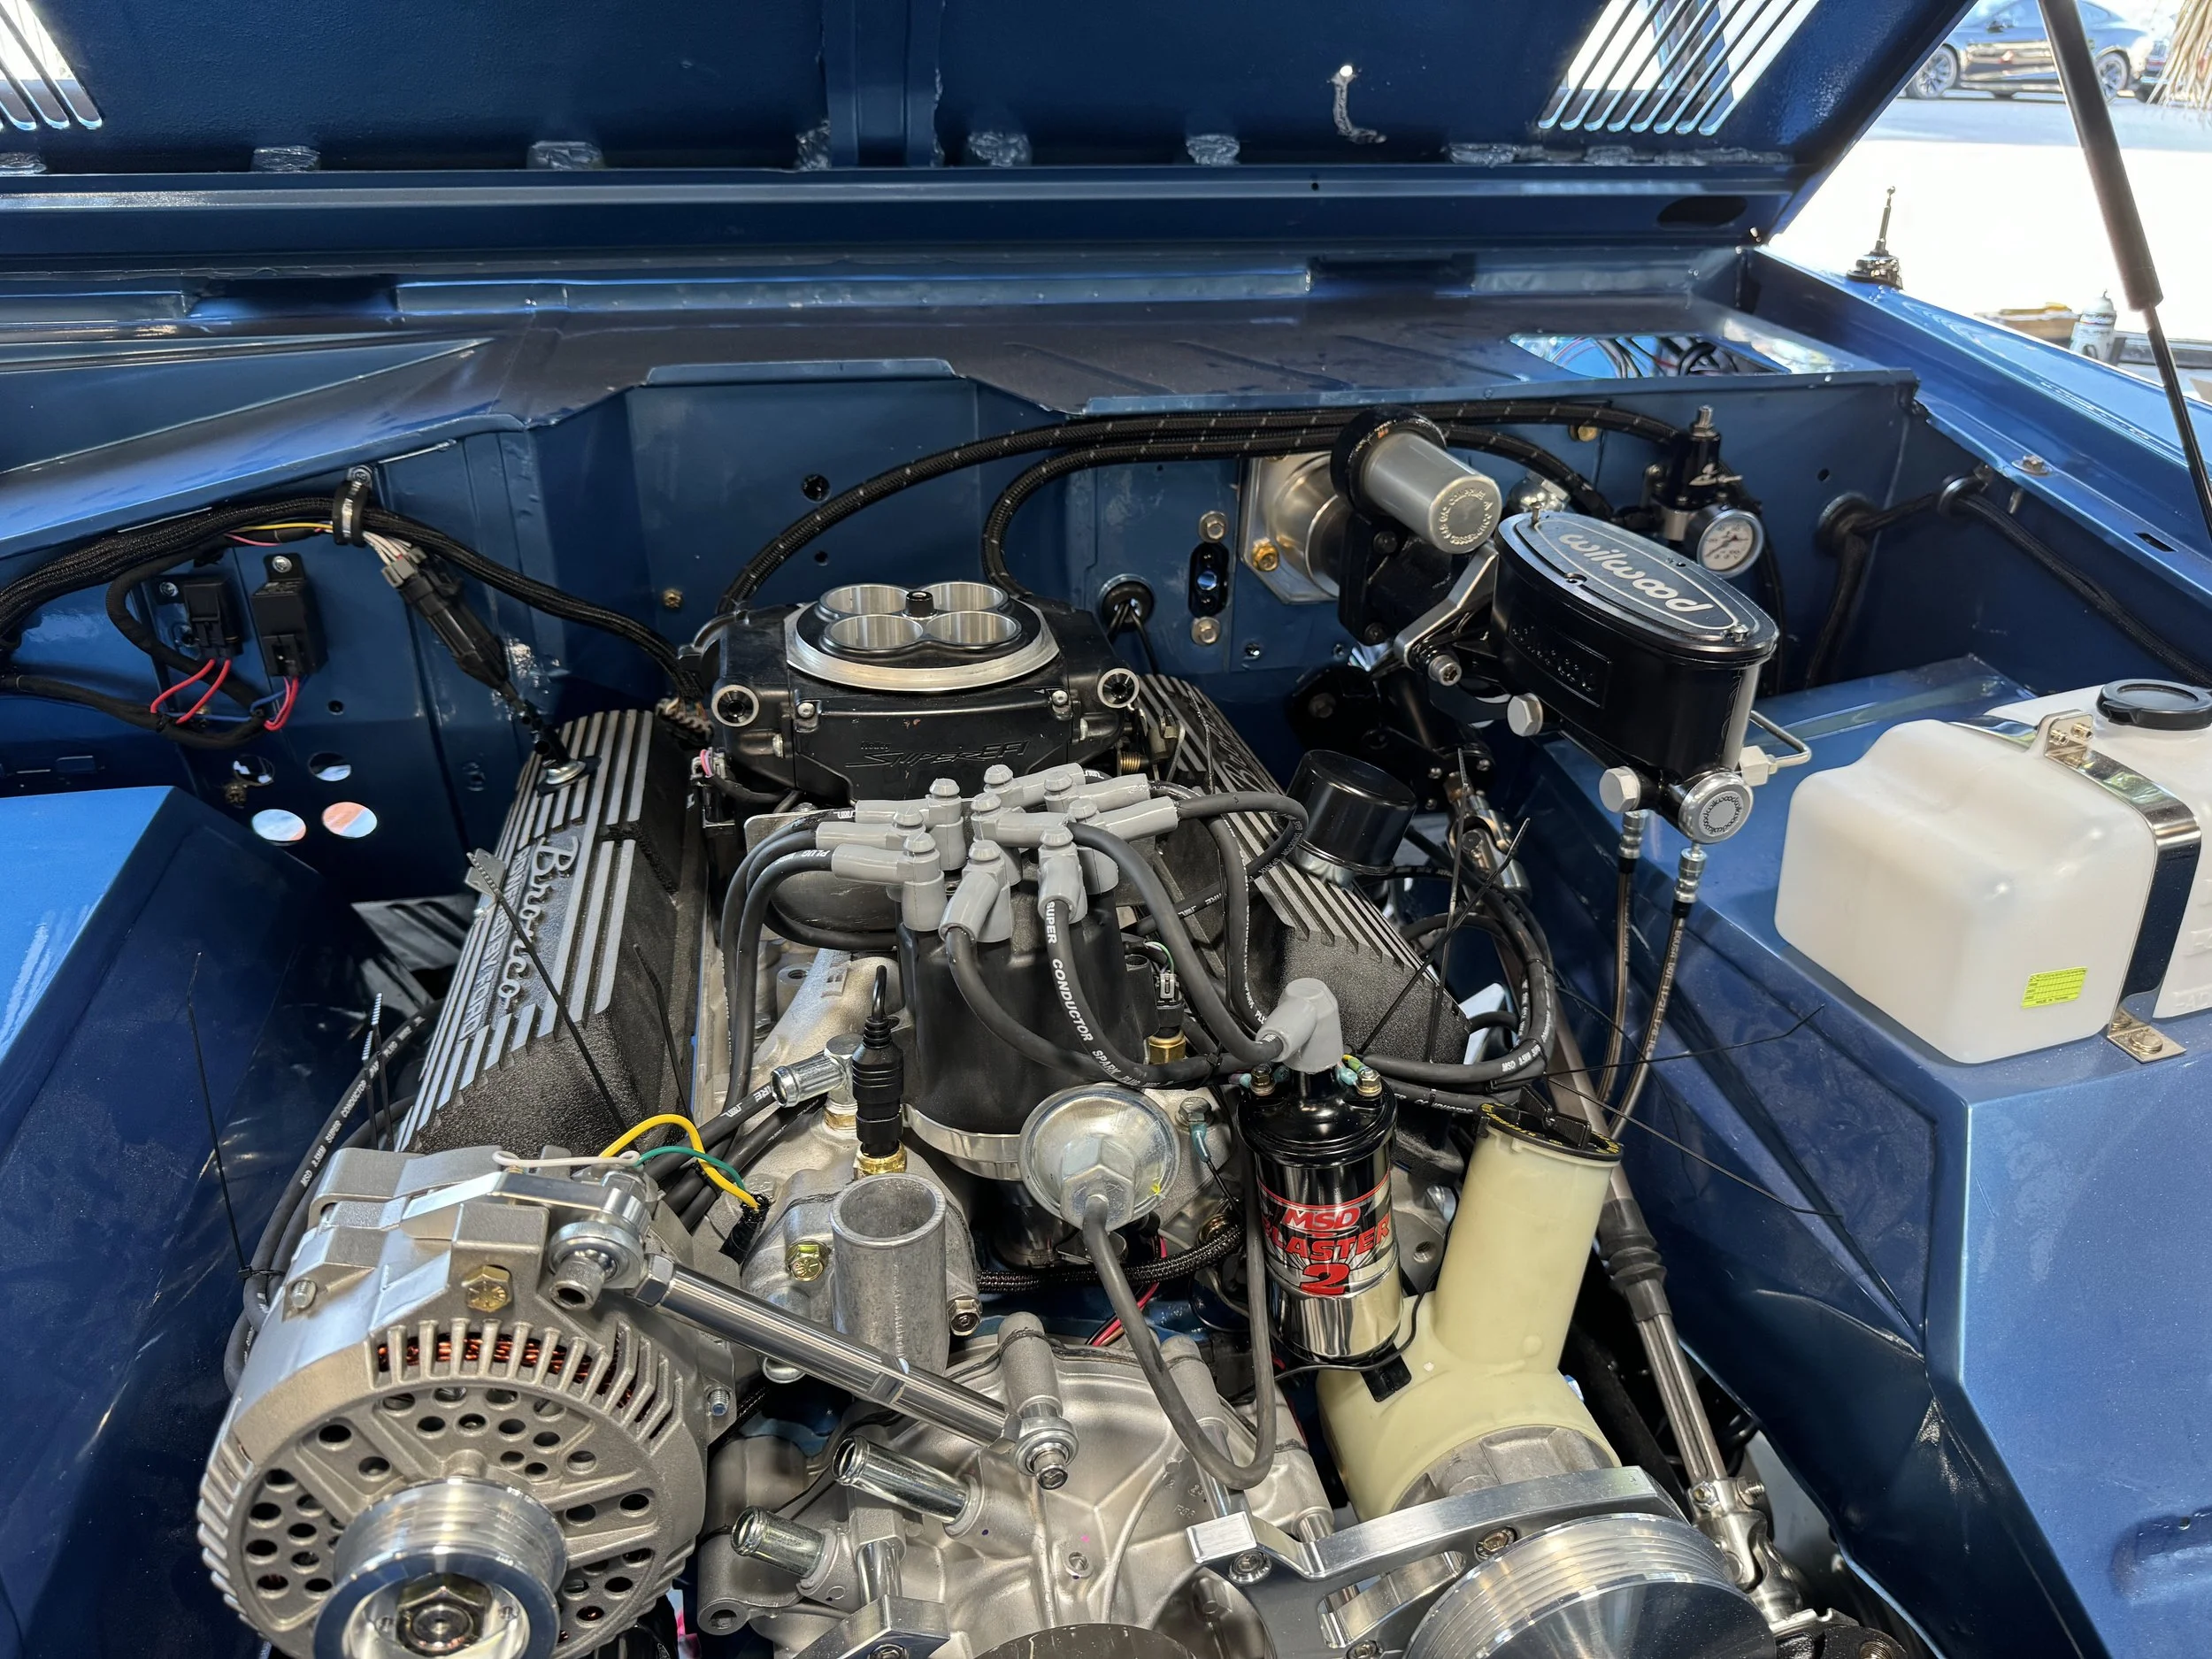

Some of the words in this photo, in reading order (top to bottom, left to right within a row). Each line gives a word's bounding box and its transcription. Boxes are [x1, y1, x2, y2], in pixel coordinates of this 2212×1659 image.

[1558, 534, 1714, 612] wilwood
[1045, 901, 1058, 944] SUPER
[1052, 958, 1094, 1042] CONDUCTOR
[1092, 1049, 1122, 1075] SPARK
[752, 1085, 772, 1102] IRE
[300, 1169, 313, 1187] MSD
[325, 1119, 342, 1144] SUPER
[341, 1079, 367, 1118] CONDUCTOR
[1281, 1207, 1362, 1231] MSD
[1299, 1262, 1351, 1296] 2
